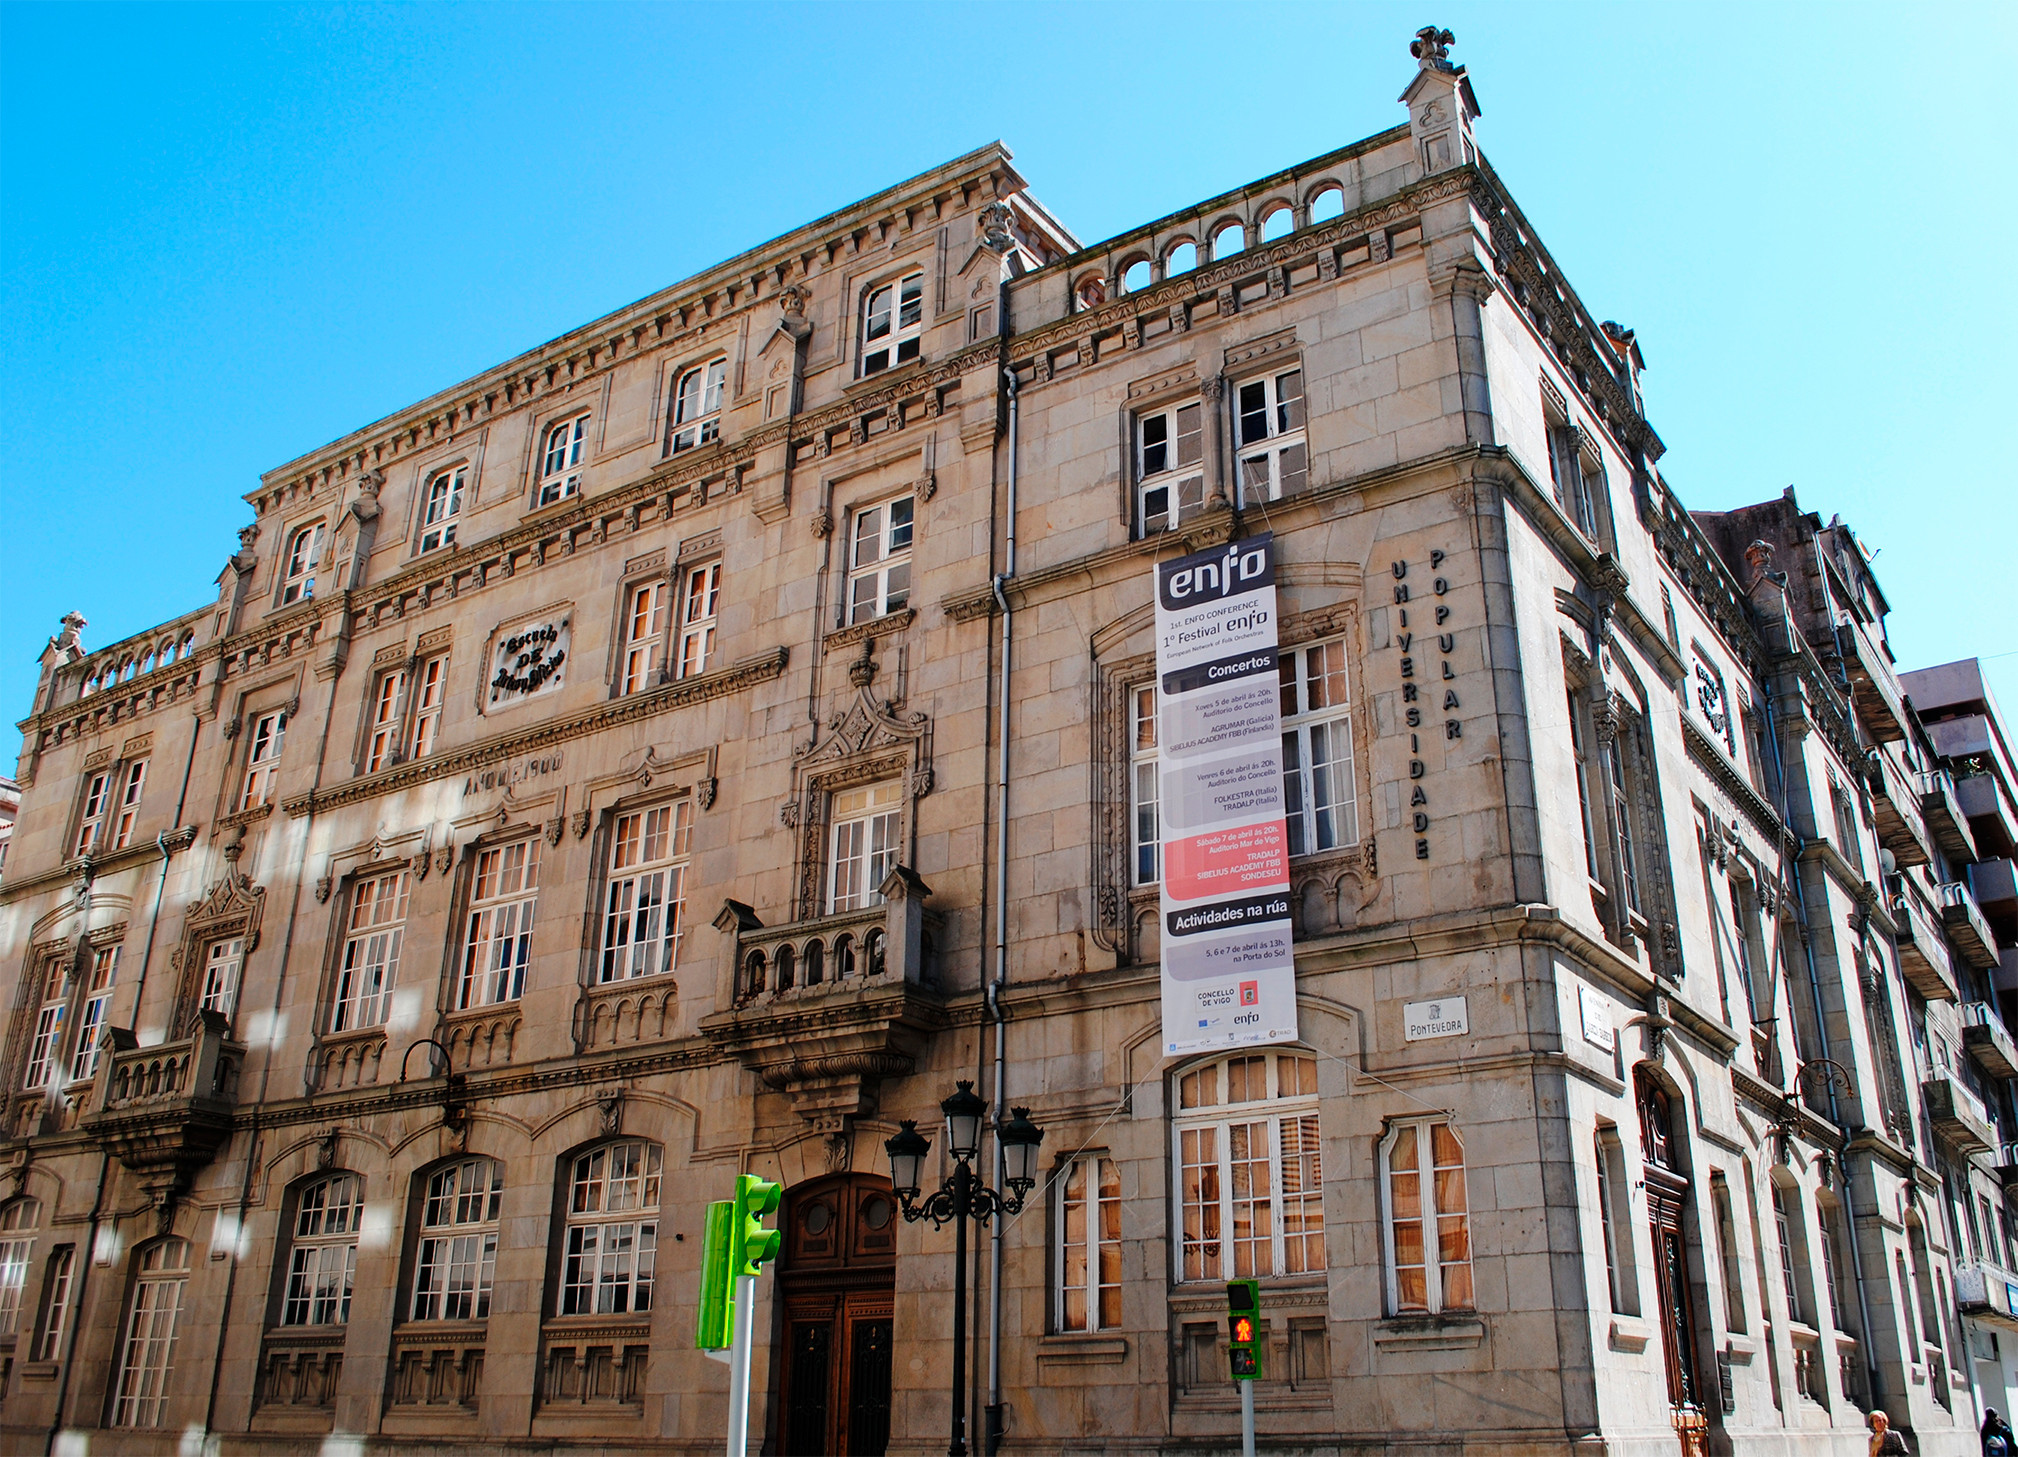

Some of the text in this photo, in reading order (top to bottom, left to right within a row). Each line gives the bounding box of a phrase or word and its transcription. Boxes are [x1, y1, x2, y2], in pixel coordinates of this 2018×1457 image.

[1169, 545, 1266, 598] enfo
[1170, 600, 1259, 630] 1st. ENFO CONFERENCE
[1178, 623, 1220, 644] Festival
[1226, 609, 1268, 632] enfo
[506, 624, 558, 654] Escuela
[1166, 648, 1191, 660] European
[1192, 642, 1214, 652] Network
[1222, 635, 1233, 644] Folk
[1234, 630, 1264, 642] Orchestras
[1430, 550, 1462, 740] POPULAR
[516, 646, 544, 669] DE
[1208, 656, 1271, 679] Concertos
[1194, 703, 1214, 712] Xoves
[1220, 698, 1230, 706] de
[1230, 693, 1247, 704] abril
[1257, 689, 1272, 698] 20h.
[1202, 697, 1274, 719] Auditorio do Concello
[1391, 559, 1429, 860] UNIVERSIDADE
[1210, 714, 1274, 733] AGRUMAR (Galicia)
[1170, 741, 1197, 753] SIBELIUS
[1197, 734, 1228, 746] ACADEMY
[1242, 722, 1274, 738] (Finlandia)
[524, 750, 564, 780] 1900
[1196, 772, 1219, 781] Venres
[1226, 767, 1234, 775] de
[1234, 764, 1250, 774] abril
[1260, 759, 1276, 768] 20h.
[1207, 768, 1277, 788] Auditorio do Concello
[1214, 786, 1278, 804] FOLKESTRA (Italia)
[1223, 795, 1278, 812] TRADALP (Italia)
[1196, 836, 1221, 848] Sábado
[1222, 834, 1227, 842] 7
[1228, 832, 1237, 841] de
[1237, 830, 1254, 840] abril
[1208, 836, 1280, 854] Auditorio Mar de Vigo
[1247, 848, 1280, 862] TRADALP
[1196, 858, 1281, 880] SIBELIUS ACADEMY FBB
[1240, 868, 1282, 882] SONDESEU
[1175, 900, 1288, 930] Actividades na rúa
[1214, 948, 1220, 956] 6
[1226, 946, 1232, 954] 7
[1232, 944, 1242, 953] de
[1242, 941, 1258, 952] abril
[1259, 940, 1268, 950] ás
[1269, 938, 1286, 948] 13h.
[1242, 952, 1262, 962] Porta
[1263, 950, 1273, 960] do
[1274, 948, 1286, 958] Sol
[1197, 988, 1235, 1000] CONCELLO
[1202, 996, 1231, 1007] DE VIGO
[1234, 1012, 1260, 1026] enfo
[1410, 1020, 1462, 1036] PONTEVEDRA
